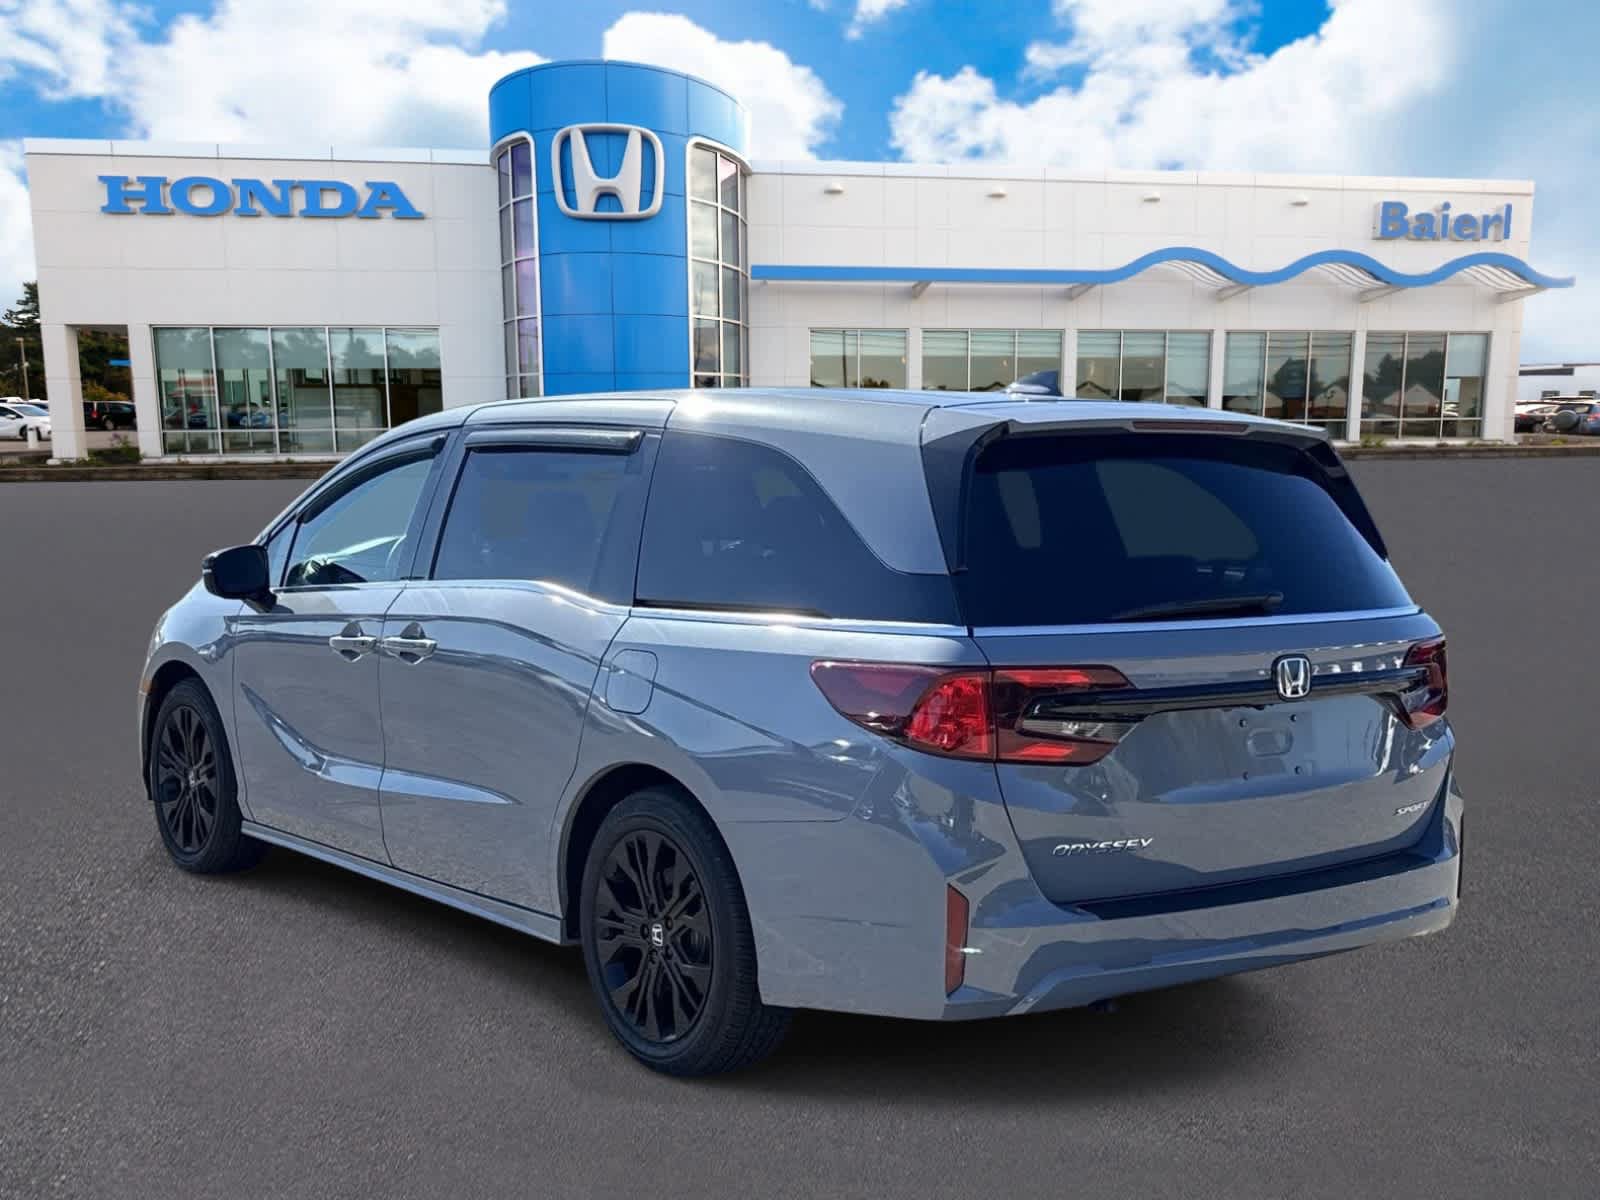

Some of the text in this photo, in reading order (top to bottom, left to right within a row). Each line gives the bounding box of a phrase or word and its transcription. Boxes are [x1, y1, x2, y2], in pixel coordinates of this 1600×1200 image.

[97, 175, 425, 219] HONDA
[1379, 200, 1513, 240] Baierl
[1052, 838, 1153, 857] ODYSSEY
